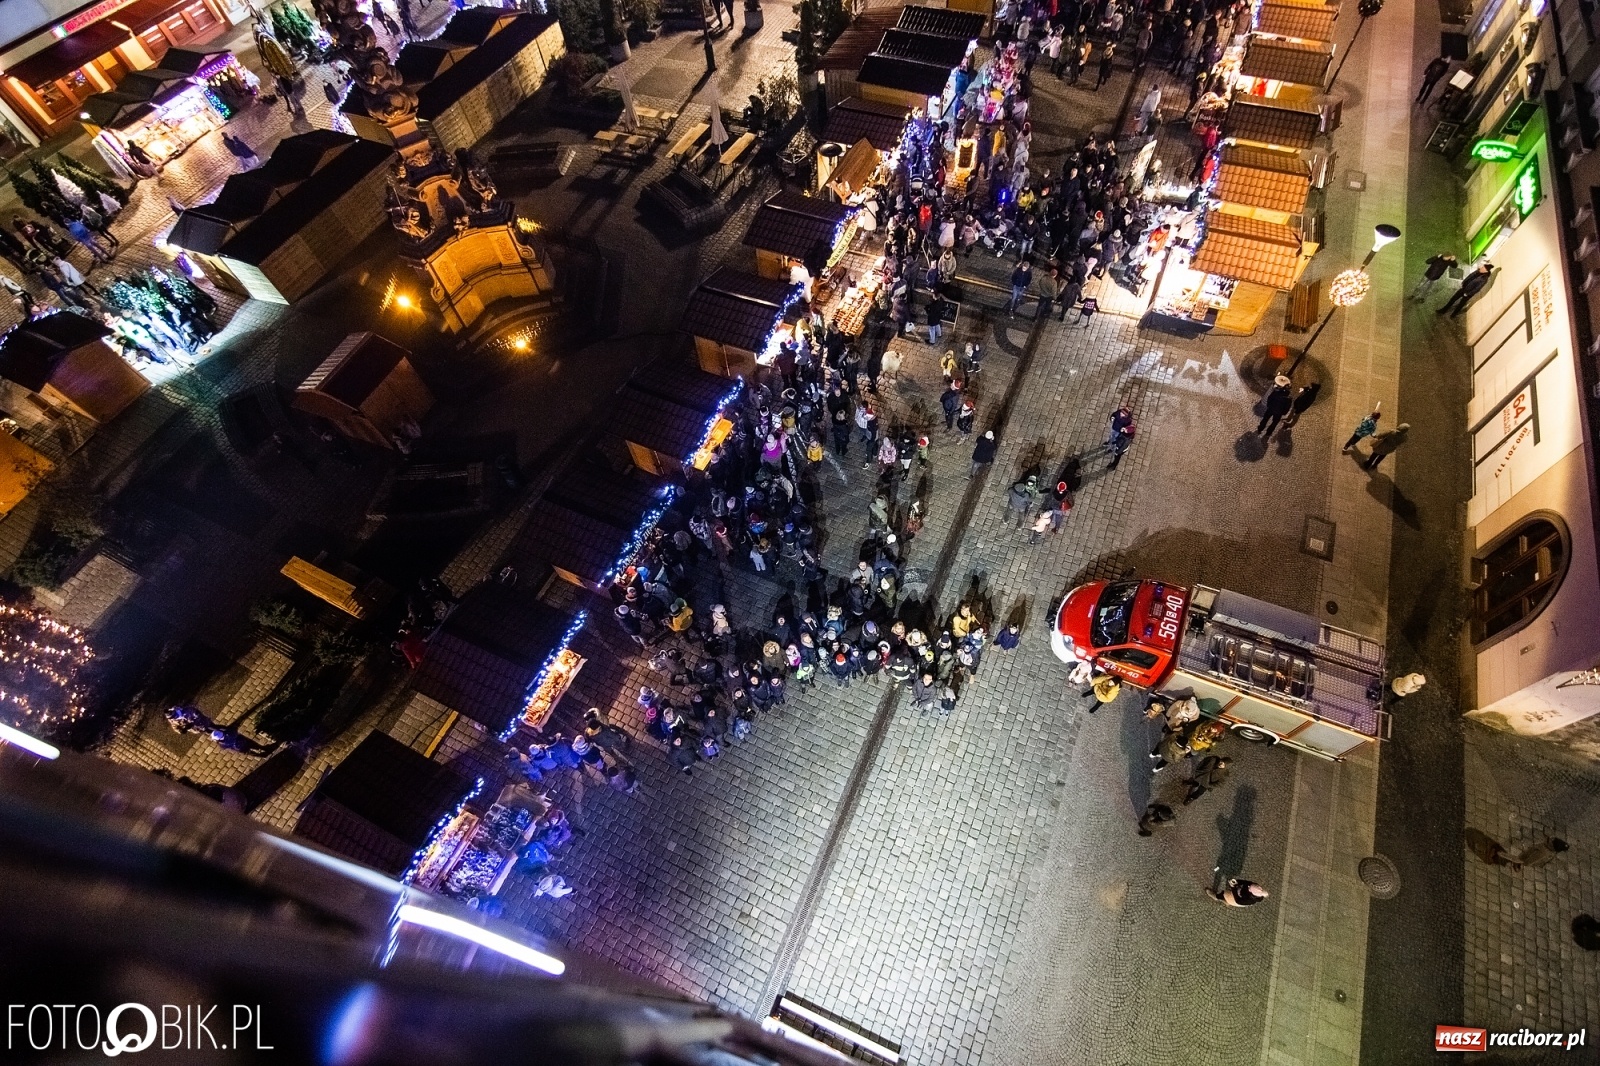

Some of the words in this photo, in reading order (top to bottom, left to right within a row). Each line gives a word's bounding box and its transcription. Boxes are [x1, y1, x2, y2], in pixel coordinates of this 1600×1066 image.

[1512, 393, 1526, 419] 64
[1516, 427, 1528, 444] 880
[1505, 444, 1517, 460] 201
[1494, 463, 1506, 479] 117
